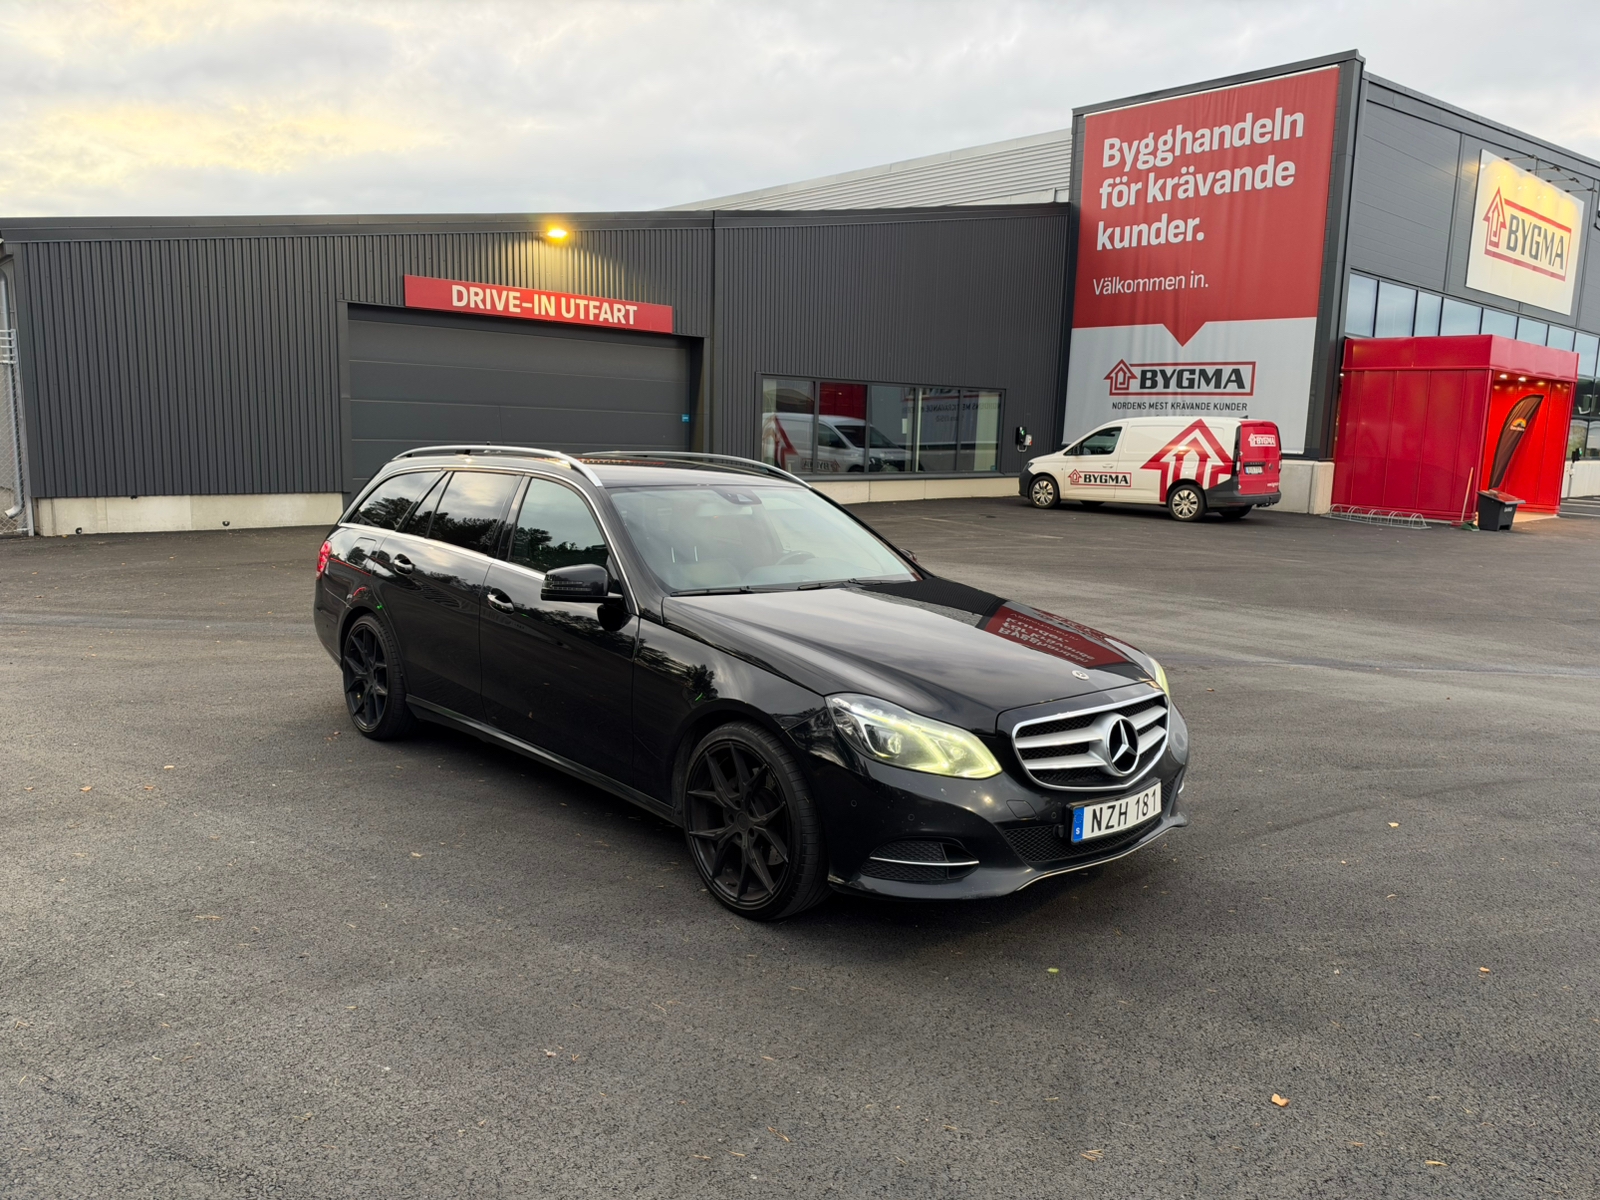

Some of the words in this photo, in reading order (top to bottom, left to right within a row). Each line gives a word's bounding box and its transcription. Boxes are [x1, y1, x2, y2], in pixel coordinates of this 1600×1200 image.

[1102, 107, 1304, 172] Bygghandeln
[1099, 176, 1142, 209] för
[1146, 155, 1296, 203] krävande
[1096, 213, 1205, 251] kunder.
[1506, 213, 1564, 270] BYGMA
[1093, 273, 1186, 296] Välkommen
[1189, 270, 1209, 289] in.
[451, 284, 556, 317] DRIVE-IN
[560, 298, 638, 325] UTFART
[1139, 368, 1246, 390] BYGMA
[1112, 401, 1147, 410] NORDENS
[1148, 401, 1169, 410] MEST
[1170, 400, 1211, 411] KRÄVANDE
[1213, 402, 1248, 411] KUNDER
[1083, 473, 1129, 485] BYGMA
[1092, 801, 1129, 833] NZH
[1134, 790, 1158, 820] 181
[1075, 827, 1081, 835] S
